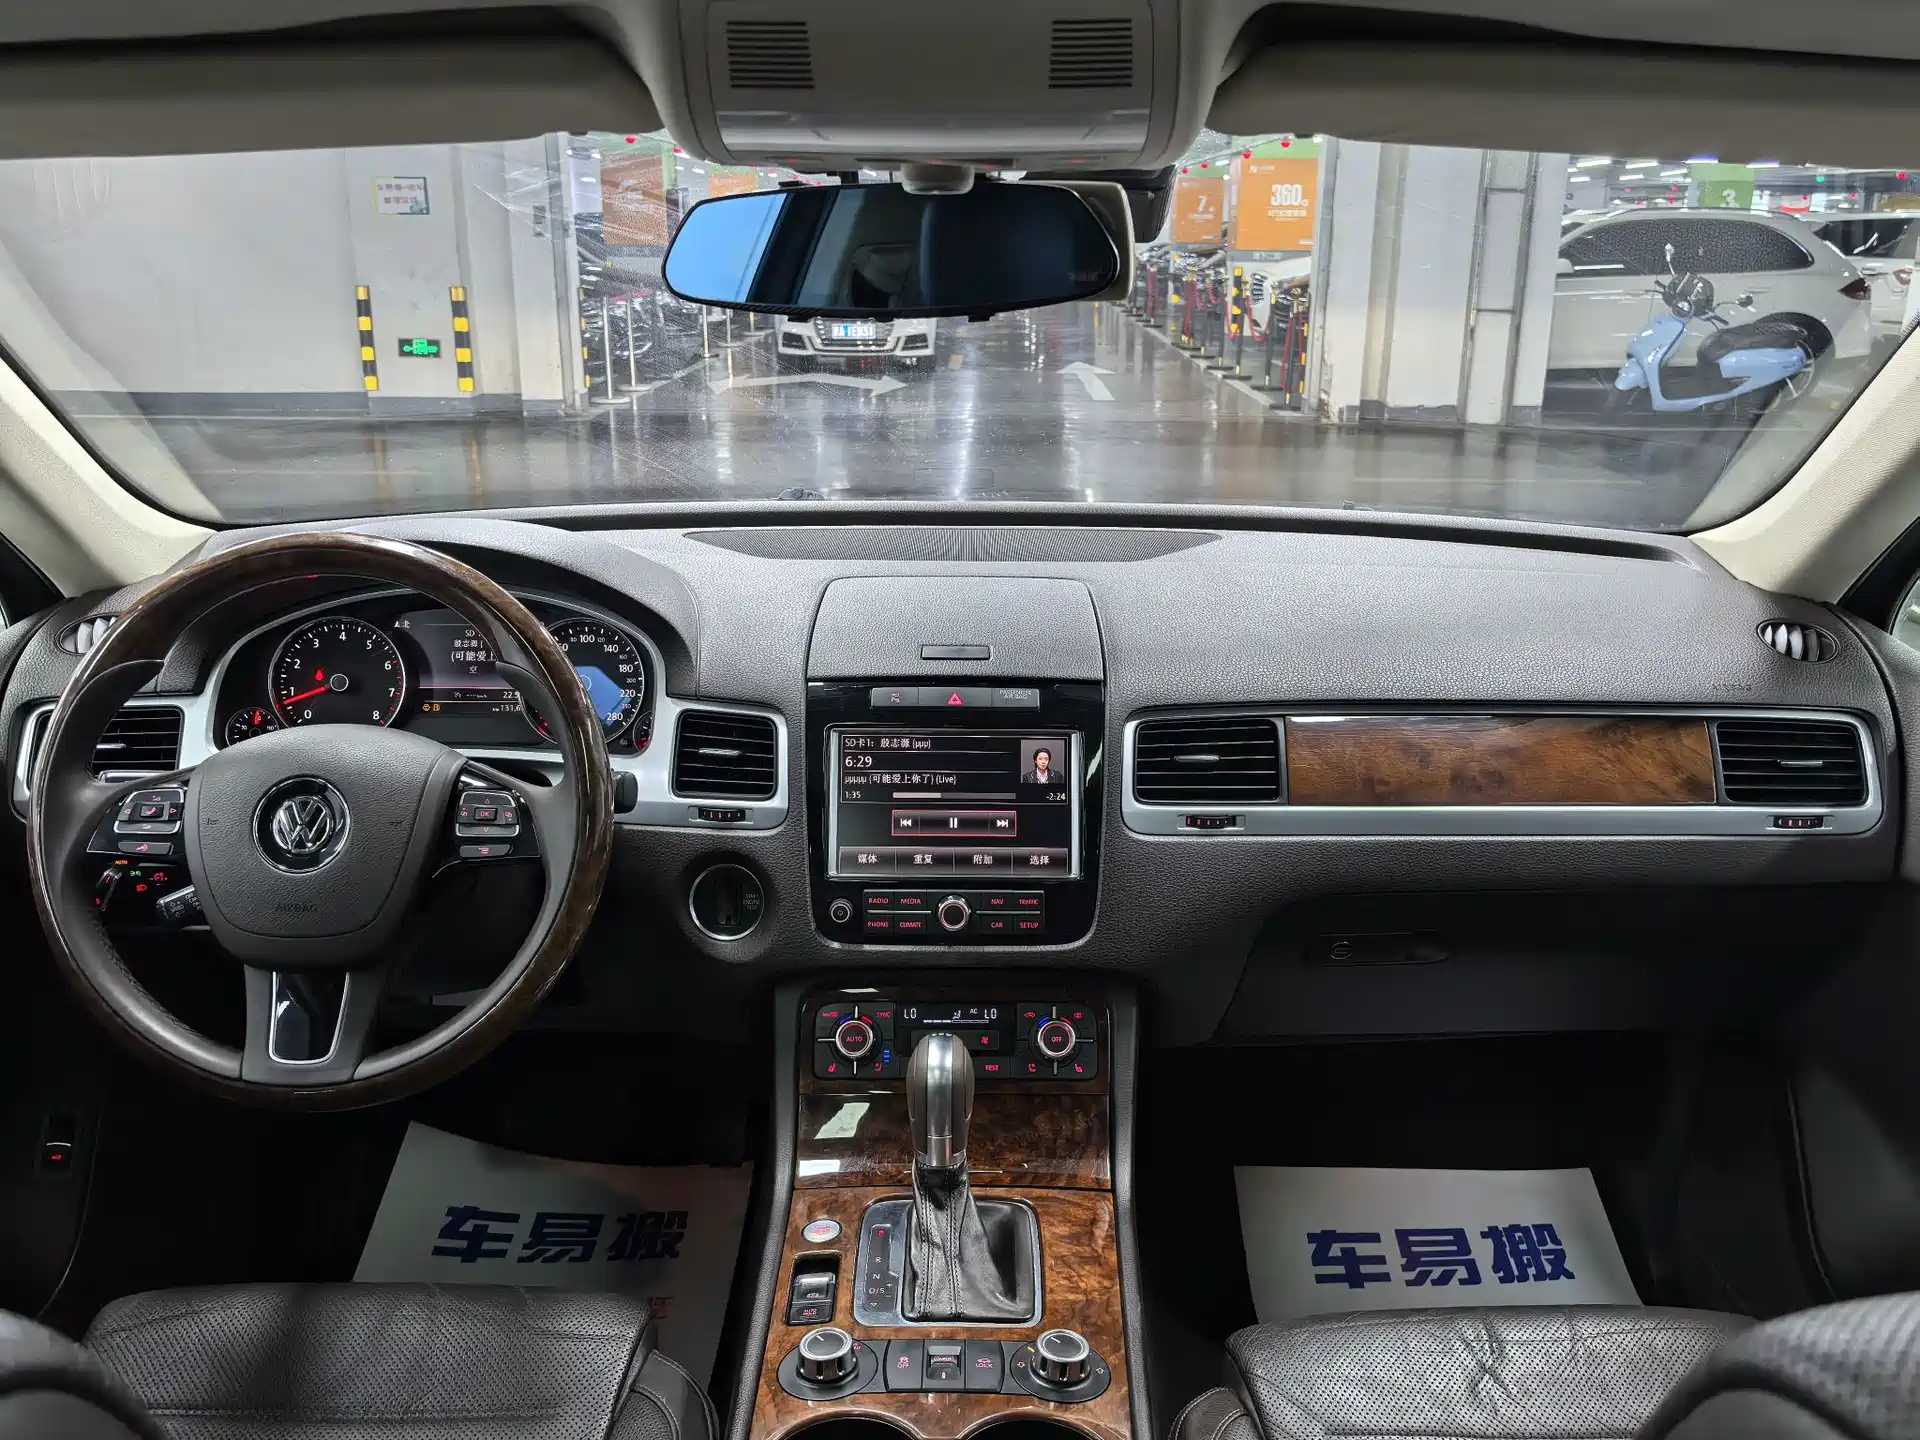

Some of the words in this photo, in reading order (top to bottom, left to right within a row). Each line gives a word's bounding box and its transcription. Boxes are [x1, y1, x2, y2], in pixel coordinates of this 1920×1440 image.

[1270, 183, 1302, 206] 360
[339, 631, 347, 641] 4
[579, 634, 595, 643] 100
[313, 639, 320, 649] 3
[366, 640, 372, 649] 5
[603, 644, 619, 653] 140
[293, 658, 301, 669] 2
[384, 661, 392, 670] 6
[618, 664, 634, 673] 180
[289, 686, 294, 696] 1
[389, 687, 395, 697] 7
[619, 689, 636, 698] 220
[304, 709, 312, 719] 0
[372, 710, 380, 720] 8
[606, 712, 624, 721] 280
[845, 755, 873, 768] 6:29
[935, 774, 957, 786] (Live)
[844, 790, 861, 799] 1:35
[1045, 792, 1067, 801] -2:24
[480, 810, 490, 818] OK
[913, 853, 934, 866] 重复
[973, 854, 993, 866] 附加
[1029, 854, 1050, 866] 选择
[868, 897, 889, 905] RADIO
[900, 897, 922, 905] MEDIA
[985, 1064, 999, 1072] REST
[431, 1204, 690, 1264] 车易搬
[877, 1229, 884, 1237] P
[1305, 1222, 1576, 1290] 车易搬
